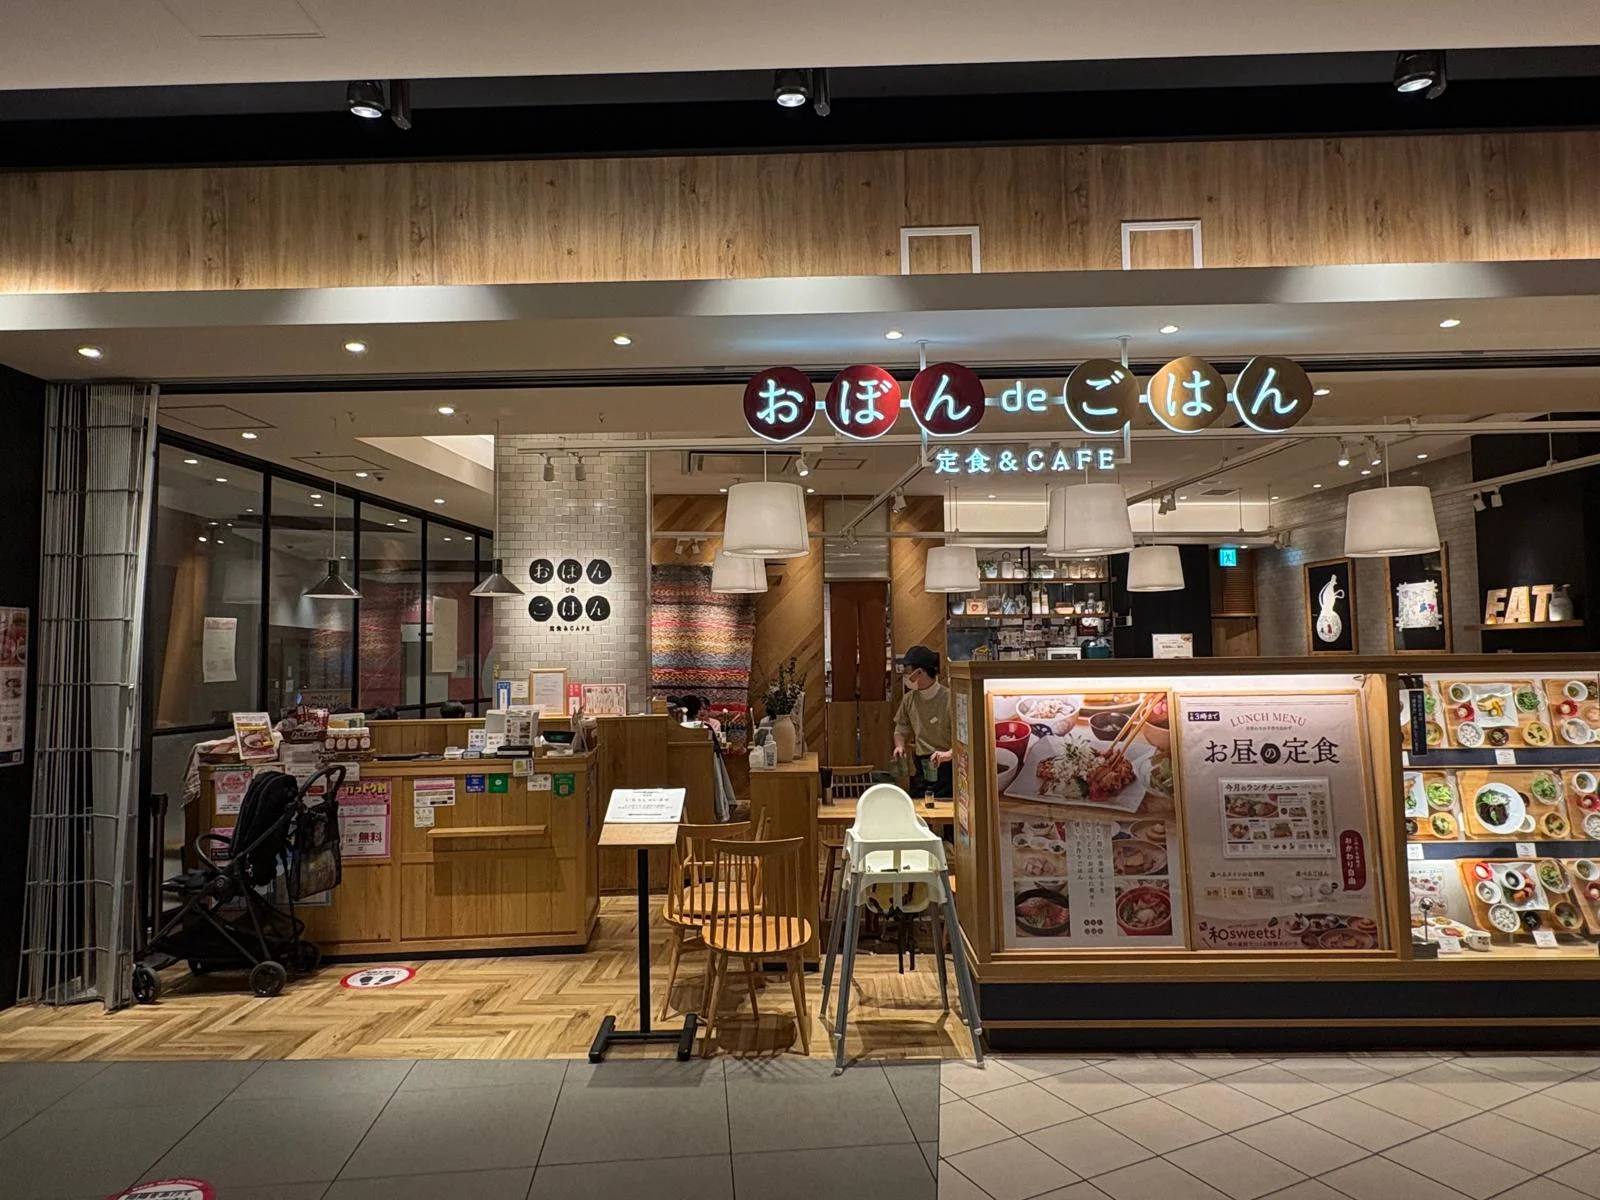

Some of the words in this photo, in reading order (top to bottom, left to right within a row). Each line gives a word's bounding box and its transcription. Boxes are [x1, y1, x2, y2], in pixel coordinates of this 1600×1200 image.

[935, 448, 1116, 474] 定食&CAFE
[1484, 584, 1554, 625] EAT
[1230, 712, 1269, 728] LUNCH
[1272, 711, 1307, 727] MENU
[1204, 736, 1340, 765] お昼の定食
[1225, 783, 1299, 792] 今月のランチメニュー
[358, 831, 383, 844] 無料
